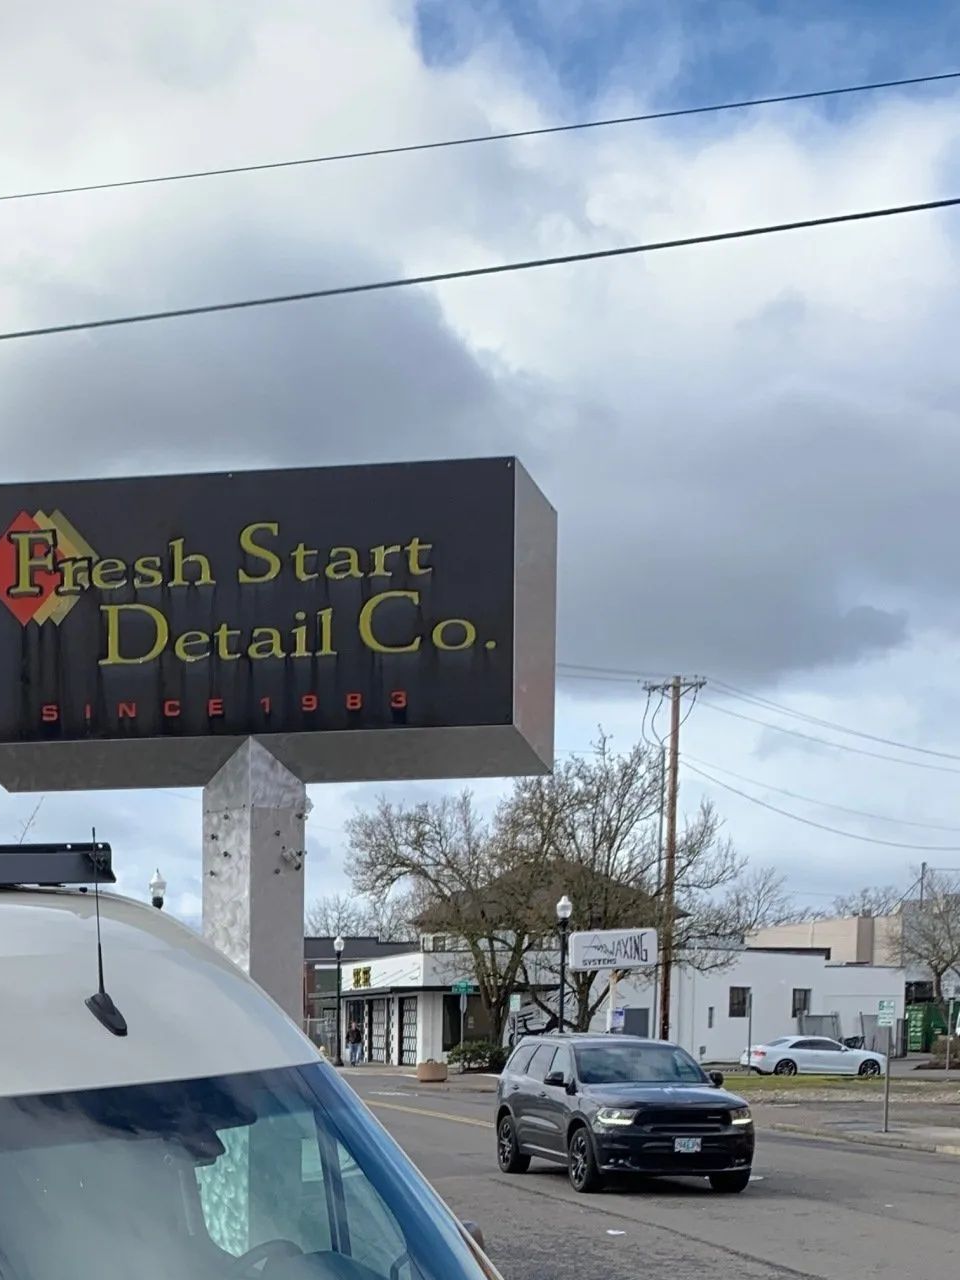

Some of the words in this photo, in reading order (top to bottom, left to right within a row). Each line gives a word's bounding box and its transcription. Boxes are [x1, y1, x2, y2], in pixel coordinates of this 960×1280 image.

[8, 530, 216, 597] Fresh
[238, 522, 433, 582] Start
[98, 602, 338, 666] Detail
[358, 590, 497, 653] Co.
[41, 697, 224, 722] SINCE
[259, 690, 409, 714] 1983
